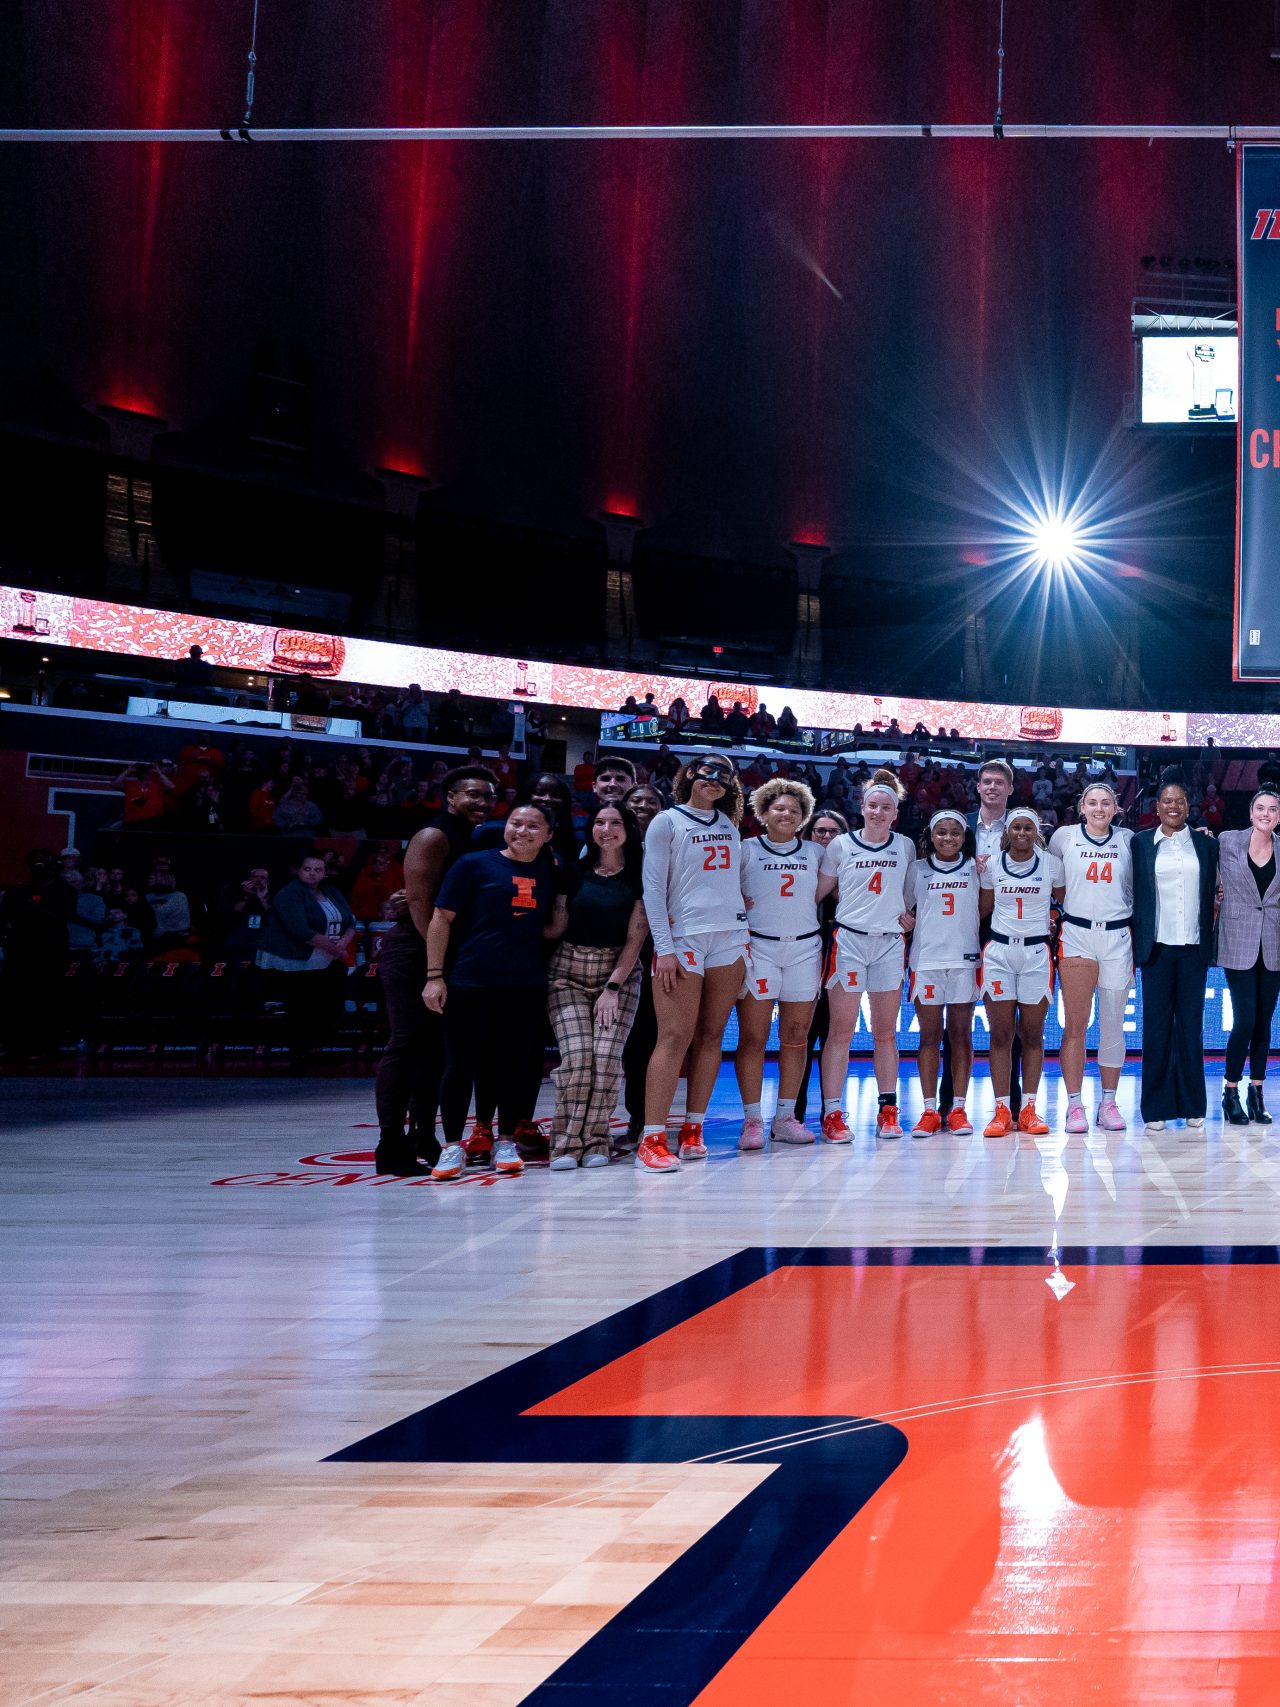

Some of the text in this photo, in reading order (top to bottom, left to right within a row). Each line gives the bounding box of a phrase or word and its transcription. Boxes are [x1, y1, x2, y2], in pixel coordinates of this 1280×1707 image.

[692, 834, 733, 843] ILLINOIS
[703, 845, 731, 871] 23
[855, 860, 898, 869] ILLINOIS
[1079, 851, 1119, 859] ILLINOIS
[763, 863, 808, 871] ILLINOIS
[1086, 861, 1113, 884] 44
[511, 876, 537, 909] I
[780, 873, 795, 897] 2
[868, 871, 882, 895] 4
[926, 881, 969, 890] ILLINOIS
[1001, 886, 1040, 894] ILLINOIS
[942, 893, 955, 915] 3
[1015, 897, 1023, 920] 1
